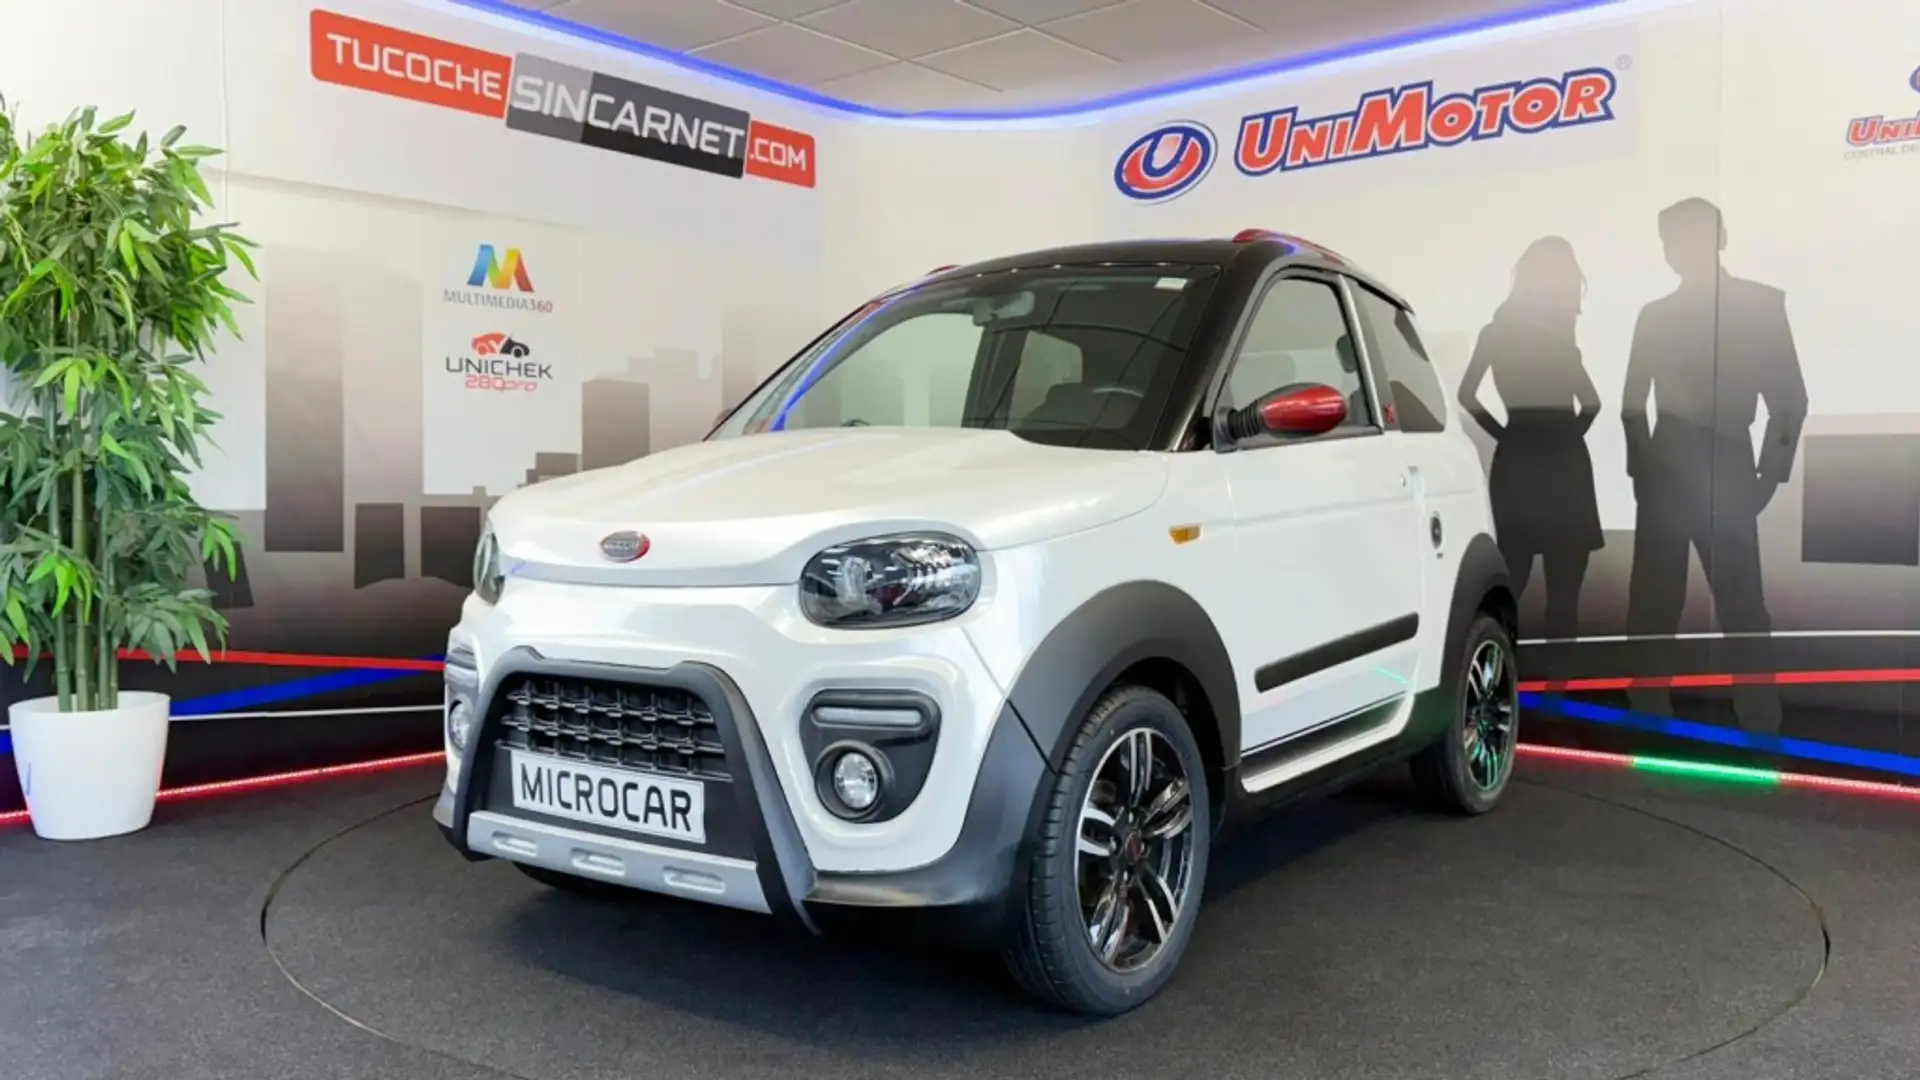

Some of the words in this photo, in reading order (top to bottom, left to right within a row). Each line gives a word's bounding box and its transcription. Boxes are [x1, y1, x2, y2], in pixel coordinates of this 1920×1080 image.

[1846, 114, 1920, 147] UNI
[443, 290, 553, 313] MULTIMEDIA360
[520, 762, 692, 832] MICROCAR
